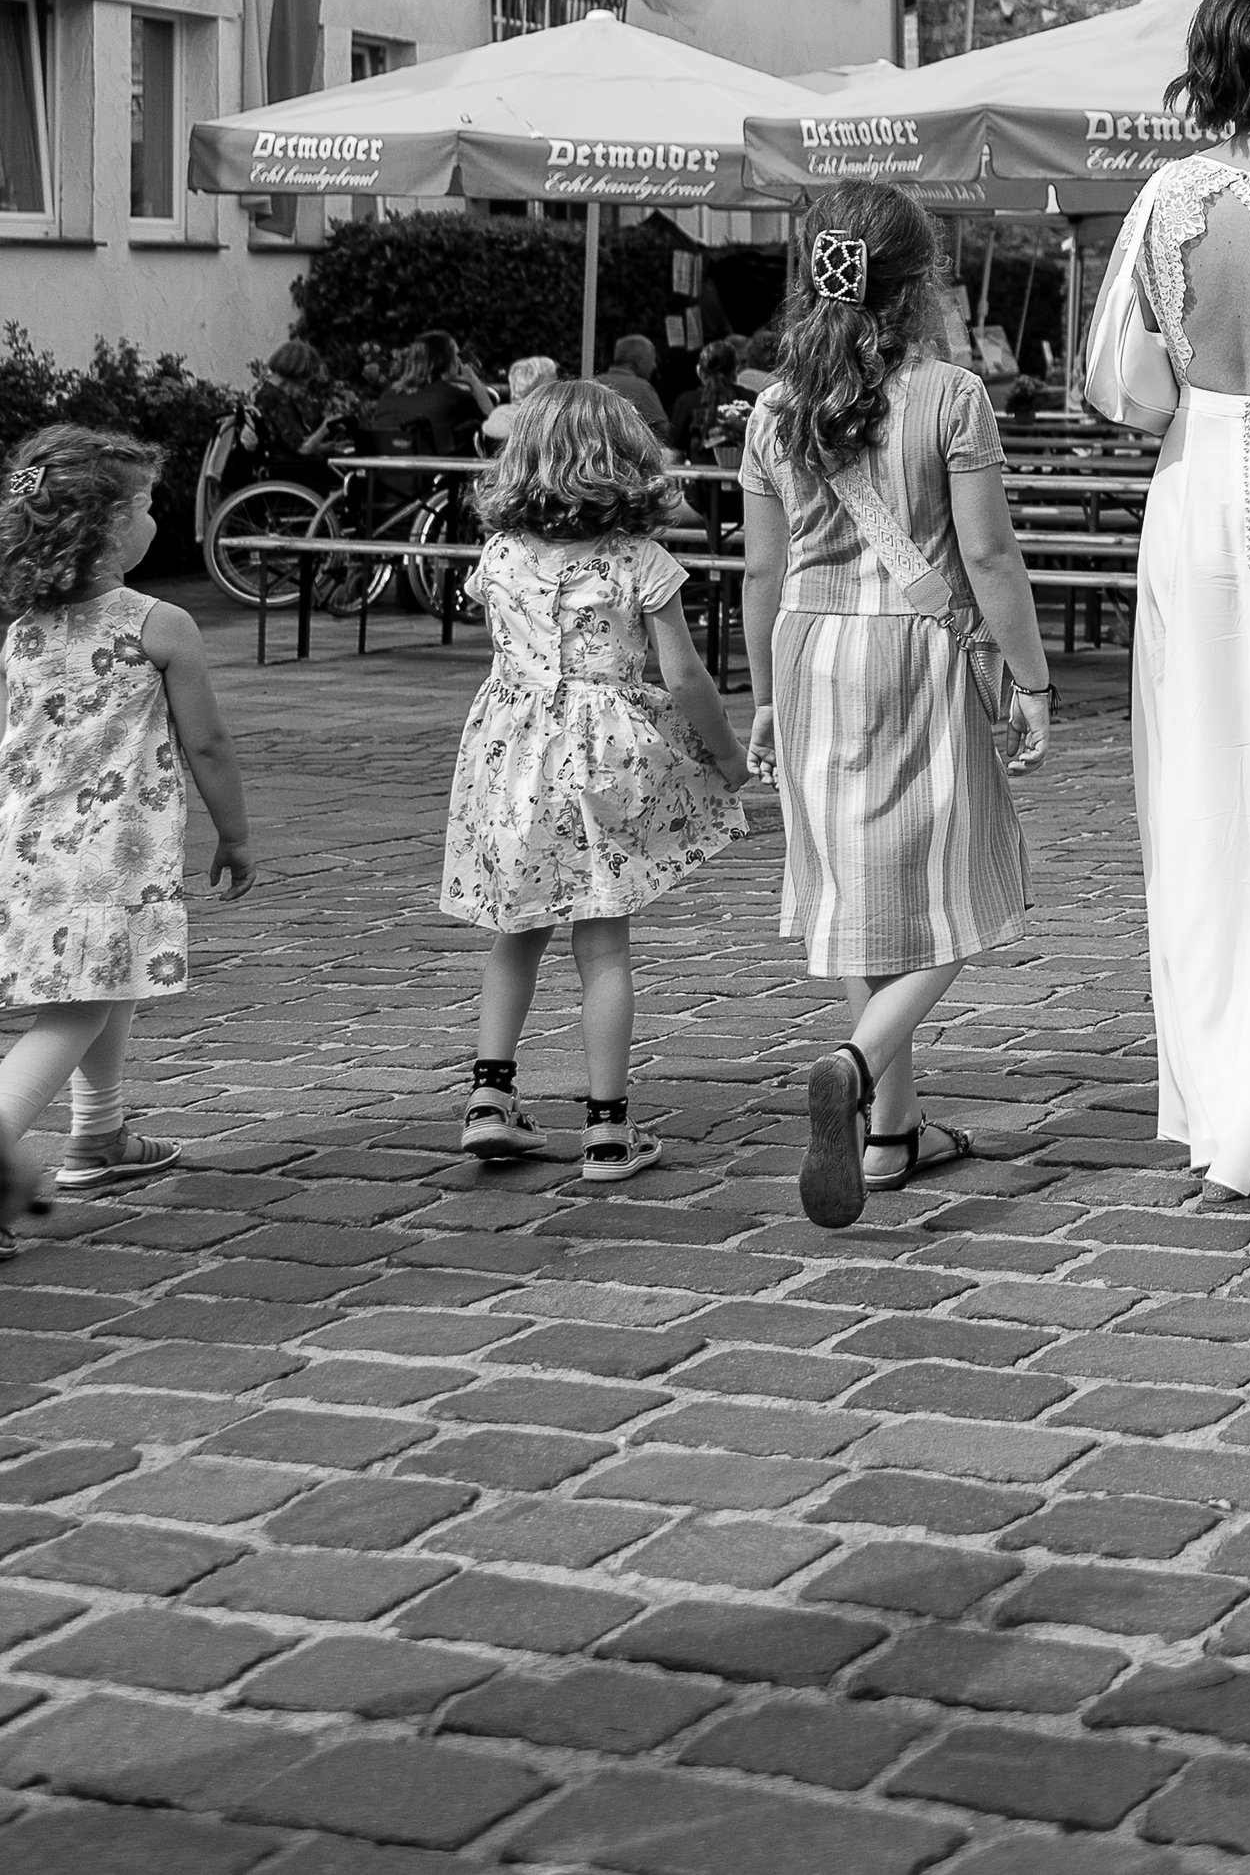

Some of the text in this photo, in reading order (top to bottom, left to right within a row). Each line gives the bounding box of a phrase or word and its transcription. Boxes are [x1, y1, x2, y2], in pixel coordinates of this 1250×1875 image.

[252, 131, 383, 162] Detmolder
[800, 116, 919, 148] Detmolder
[547, 139, 719, 173] Detmolder
[807, 148, 924, 181] Echt handgebraut
[1086, 146, 1139, 170] Echt
[250, 161, 379, 192] Echt handgebraut
[545, 170, 716, 201] Echt handgebraut
